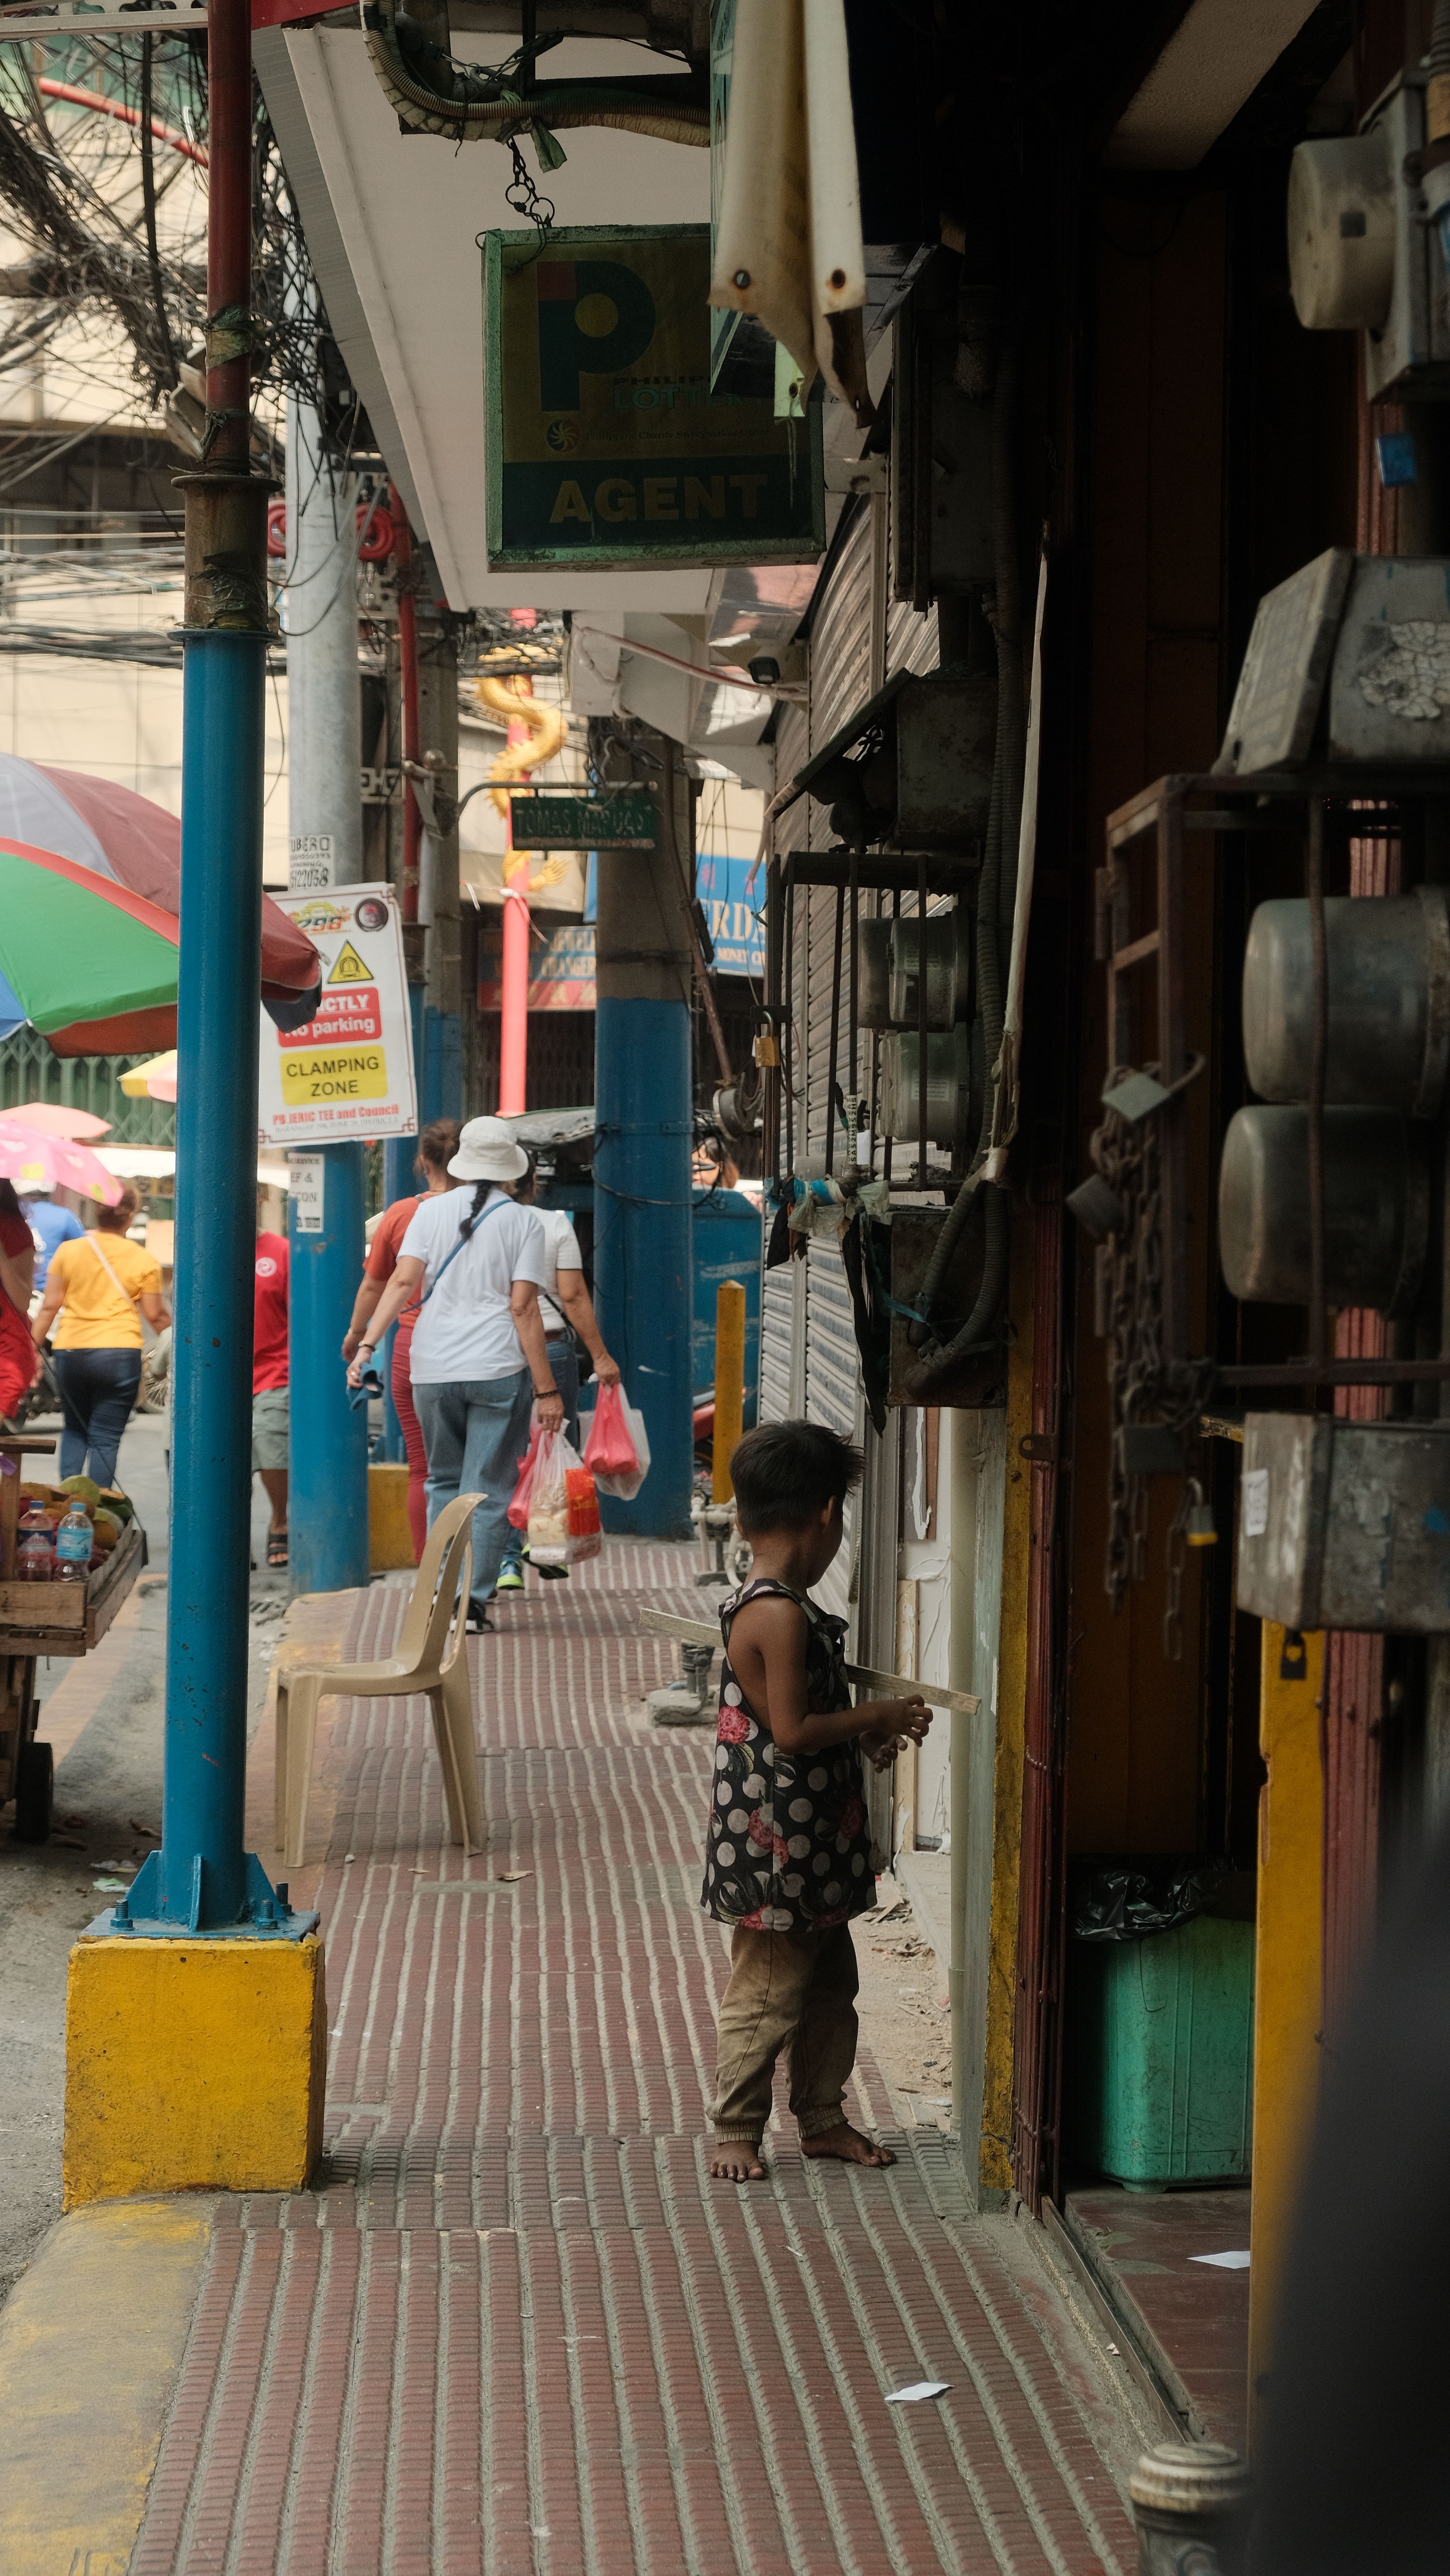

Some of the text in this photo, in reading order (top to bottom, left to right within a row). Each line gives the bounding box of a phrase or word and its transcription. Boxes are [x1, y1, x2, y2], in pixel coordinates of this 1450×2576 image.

[614, 376, 711, 386] PHILIP
[549, 474, 768, 523] AGENT
[717, 947, 750, 963] MONEY
[316, 994, 369, 1012] ICTLY
[285, 1016, 376, 1039] o parking
[286, 1056, 379, 1077] CLAMPING
[310, 1080, 358, 1097] ZONE
[317, 1109, 334, 1121] TEE
[336, 1108, 356, 1119] and
[358, 1103, 399, 1118] Council
[304, 1172, 313, 1183] &
[291, 1191, 317, 1202] CON
